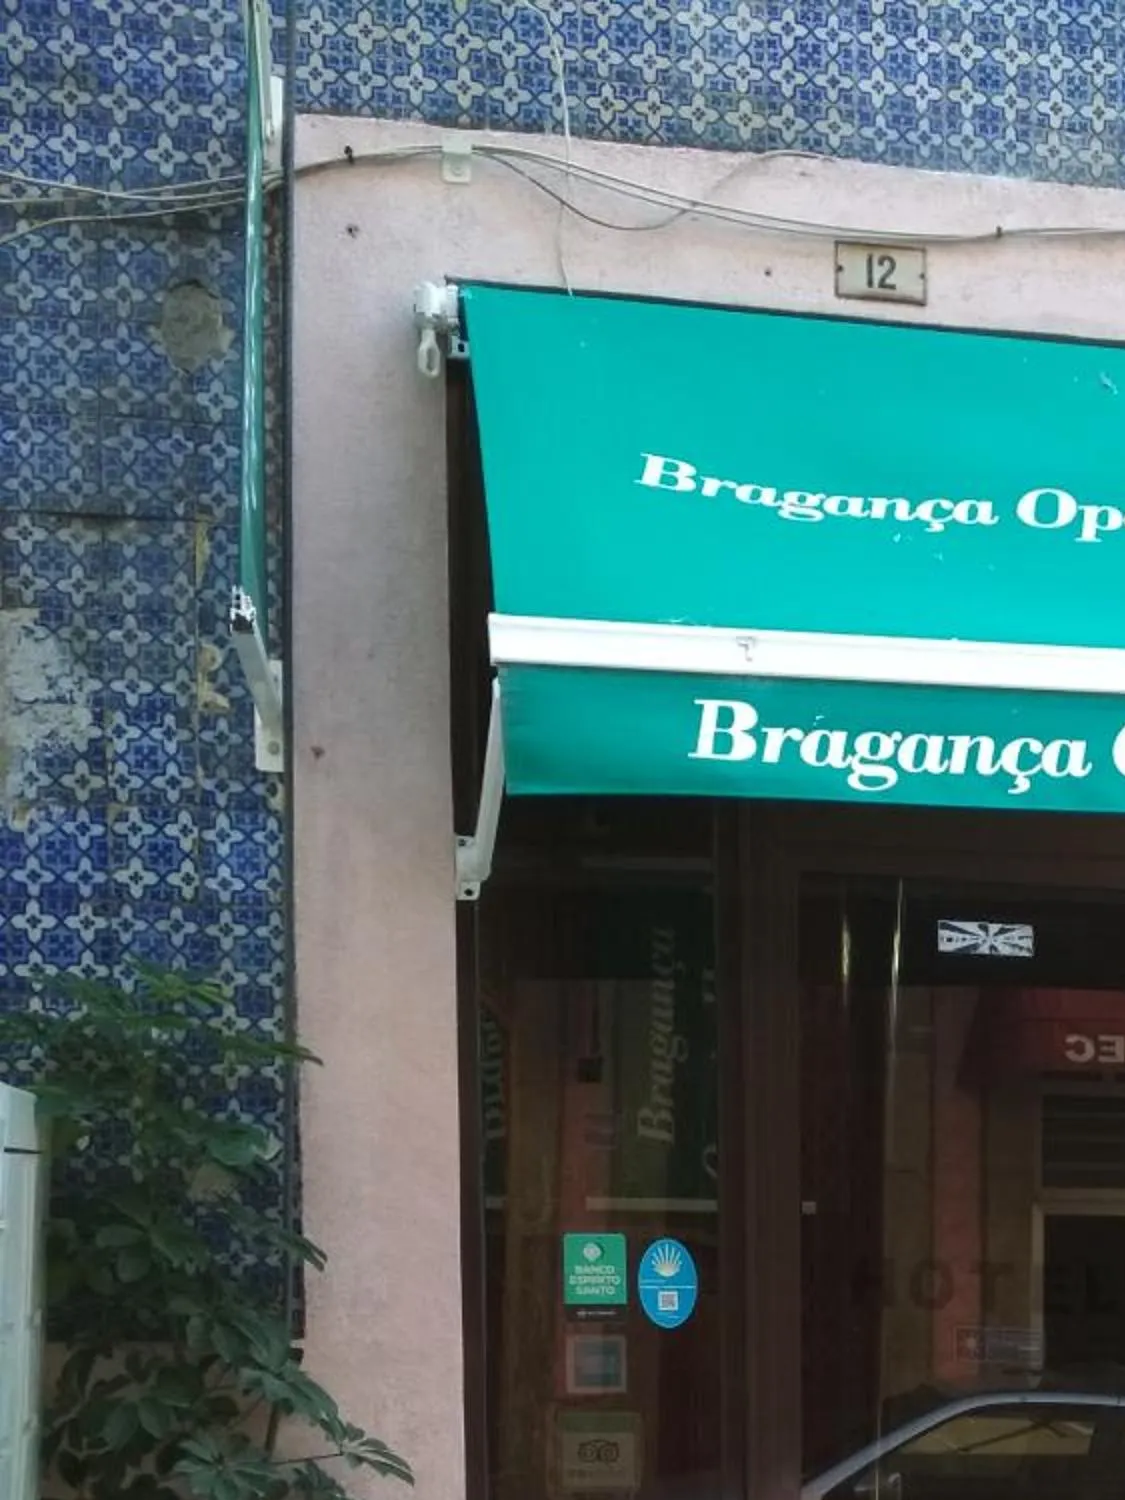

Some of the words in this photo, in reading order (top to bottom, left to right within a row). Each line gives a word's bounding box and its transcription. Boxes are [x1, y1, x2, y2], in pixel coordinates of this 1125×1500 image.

[866, 254, 897, 290] 12
[634, 453, 999, 533] Bragança
[688, 698, 1092, 795] Bragança
[574, 1265, 615, 1275] BANCO
[575, 1286, 616, 1296] SANTO
